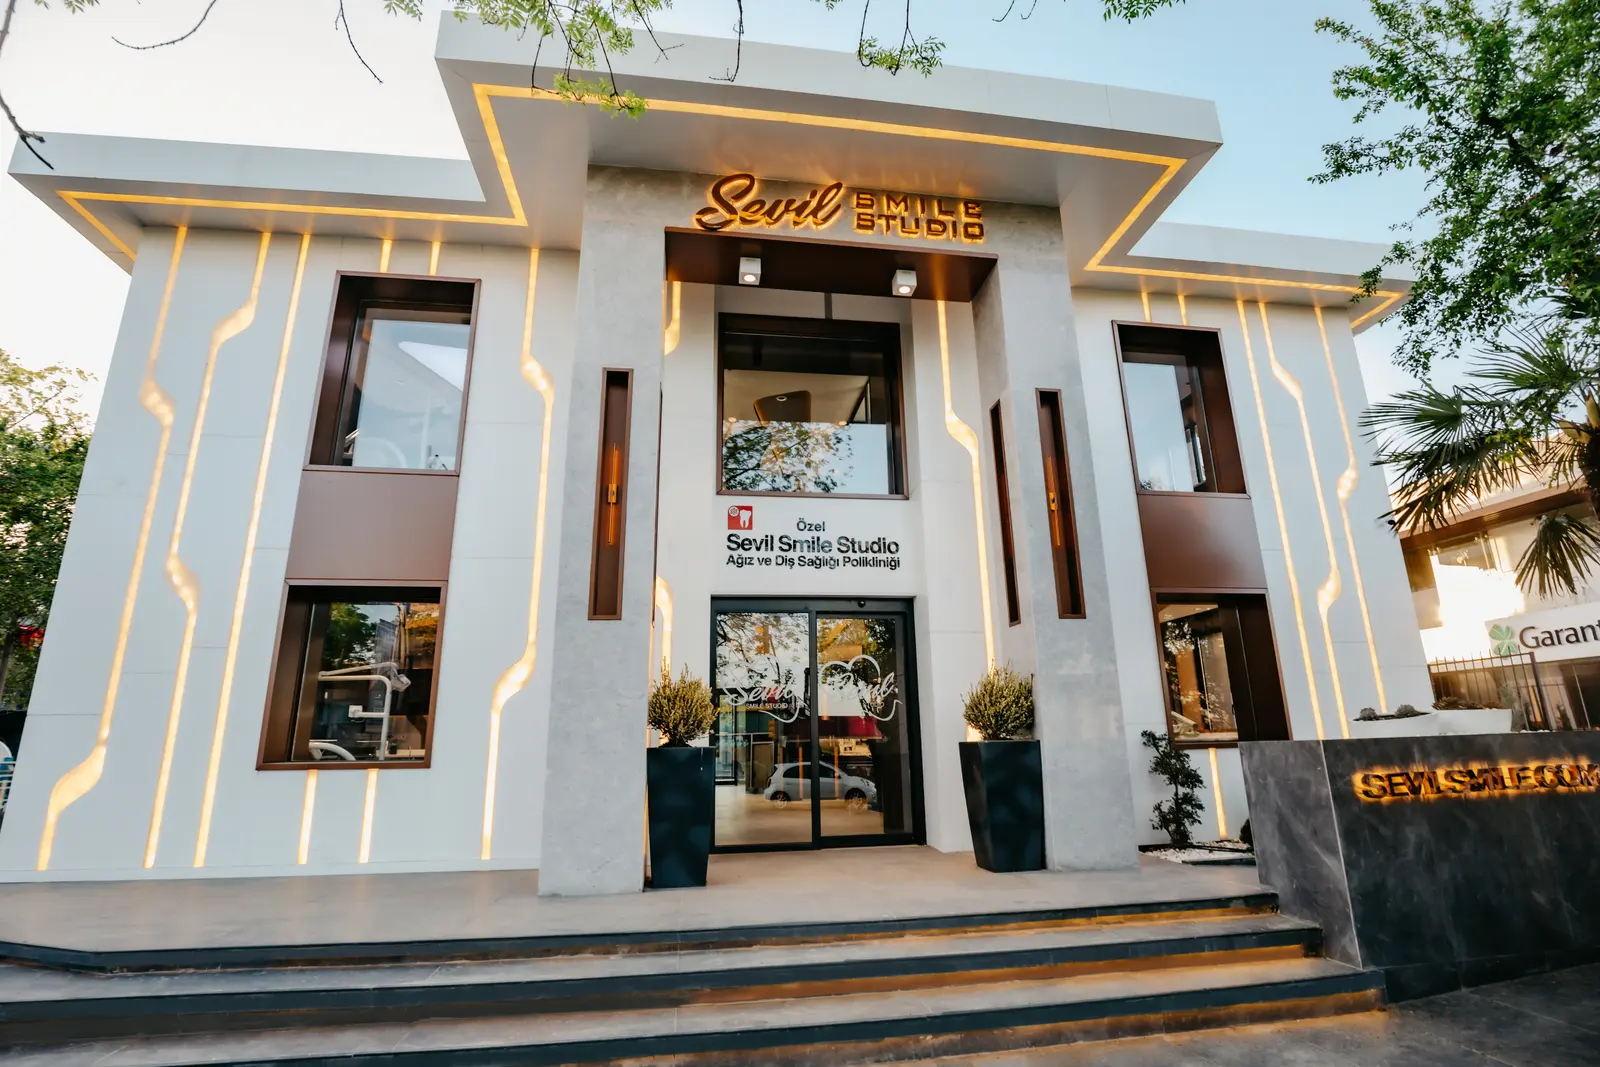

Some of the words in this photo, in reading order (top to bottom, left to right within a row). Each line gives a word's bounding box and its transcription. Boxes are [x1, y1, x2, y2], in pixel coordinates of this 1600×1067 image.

[695, 173, 843, 231] Sevil
[856, 191, 982, 220] SMILE
[856, 212, 985, 241] STUDIO
[796, 518, 825, 532] Özel
[726, 533, 774, 552] Sevil
[778, 534, 832, 553] Smile
[836, 536, 900, 554] Studio
[726, 554, 754, 568] Ağız
[757, 557, 772, 566] ve
[775, 555, 795, 569] Diş
[797, 556, 840, 569] Sağlığı
[842, 556, 901, 570] Polikliniği
